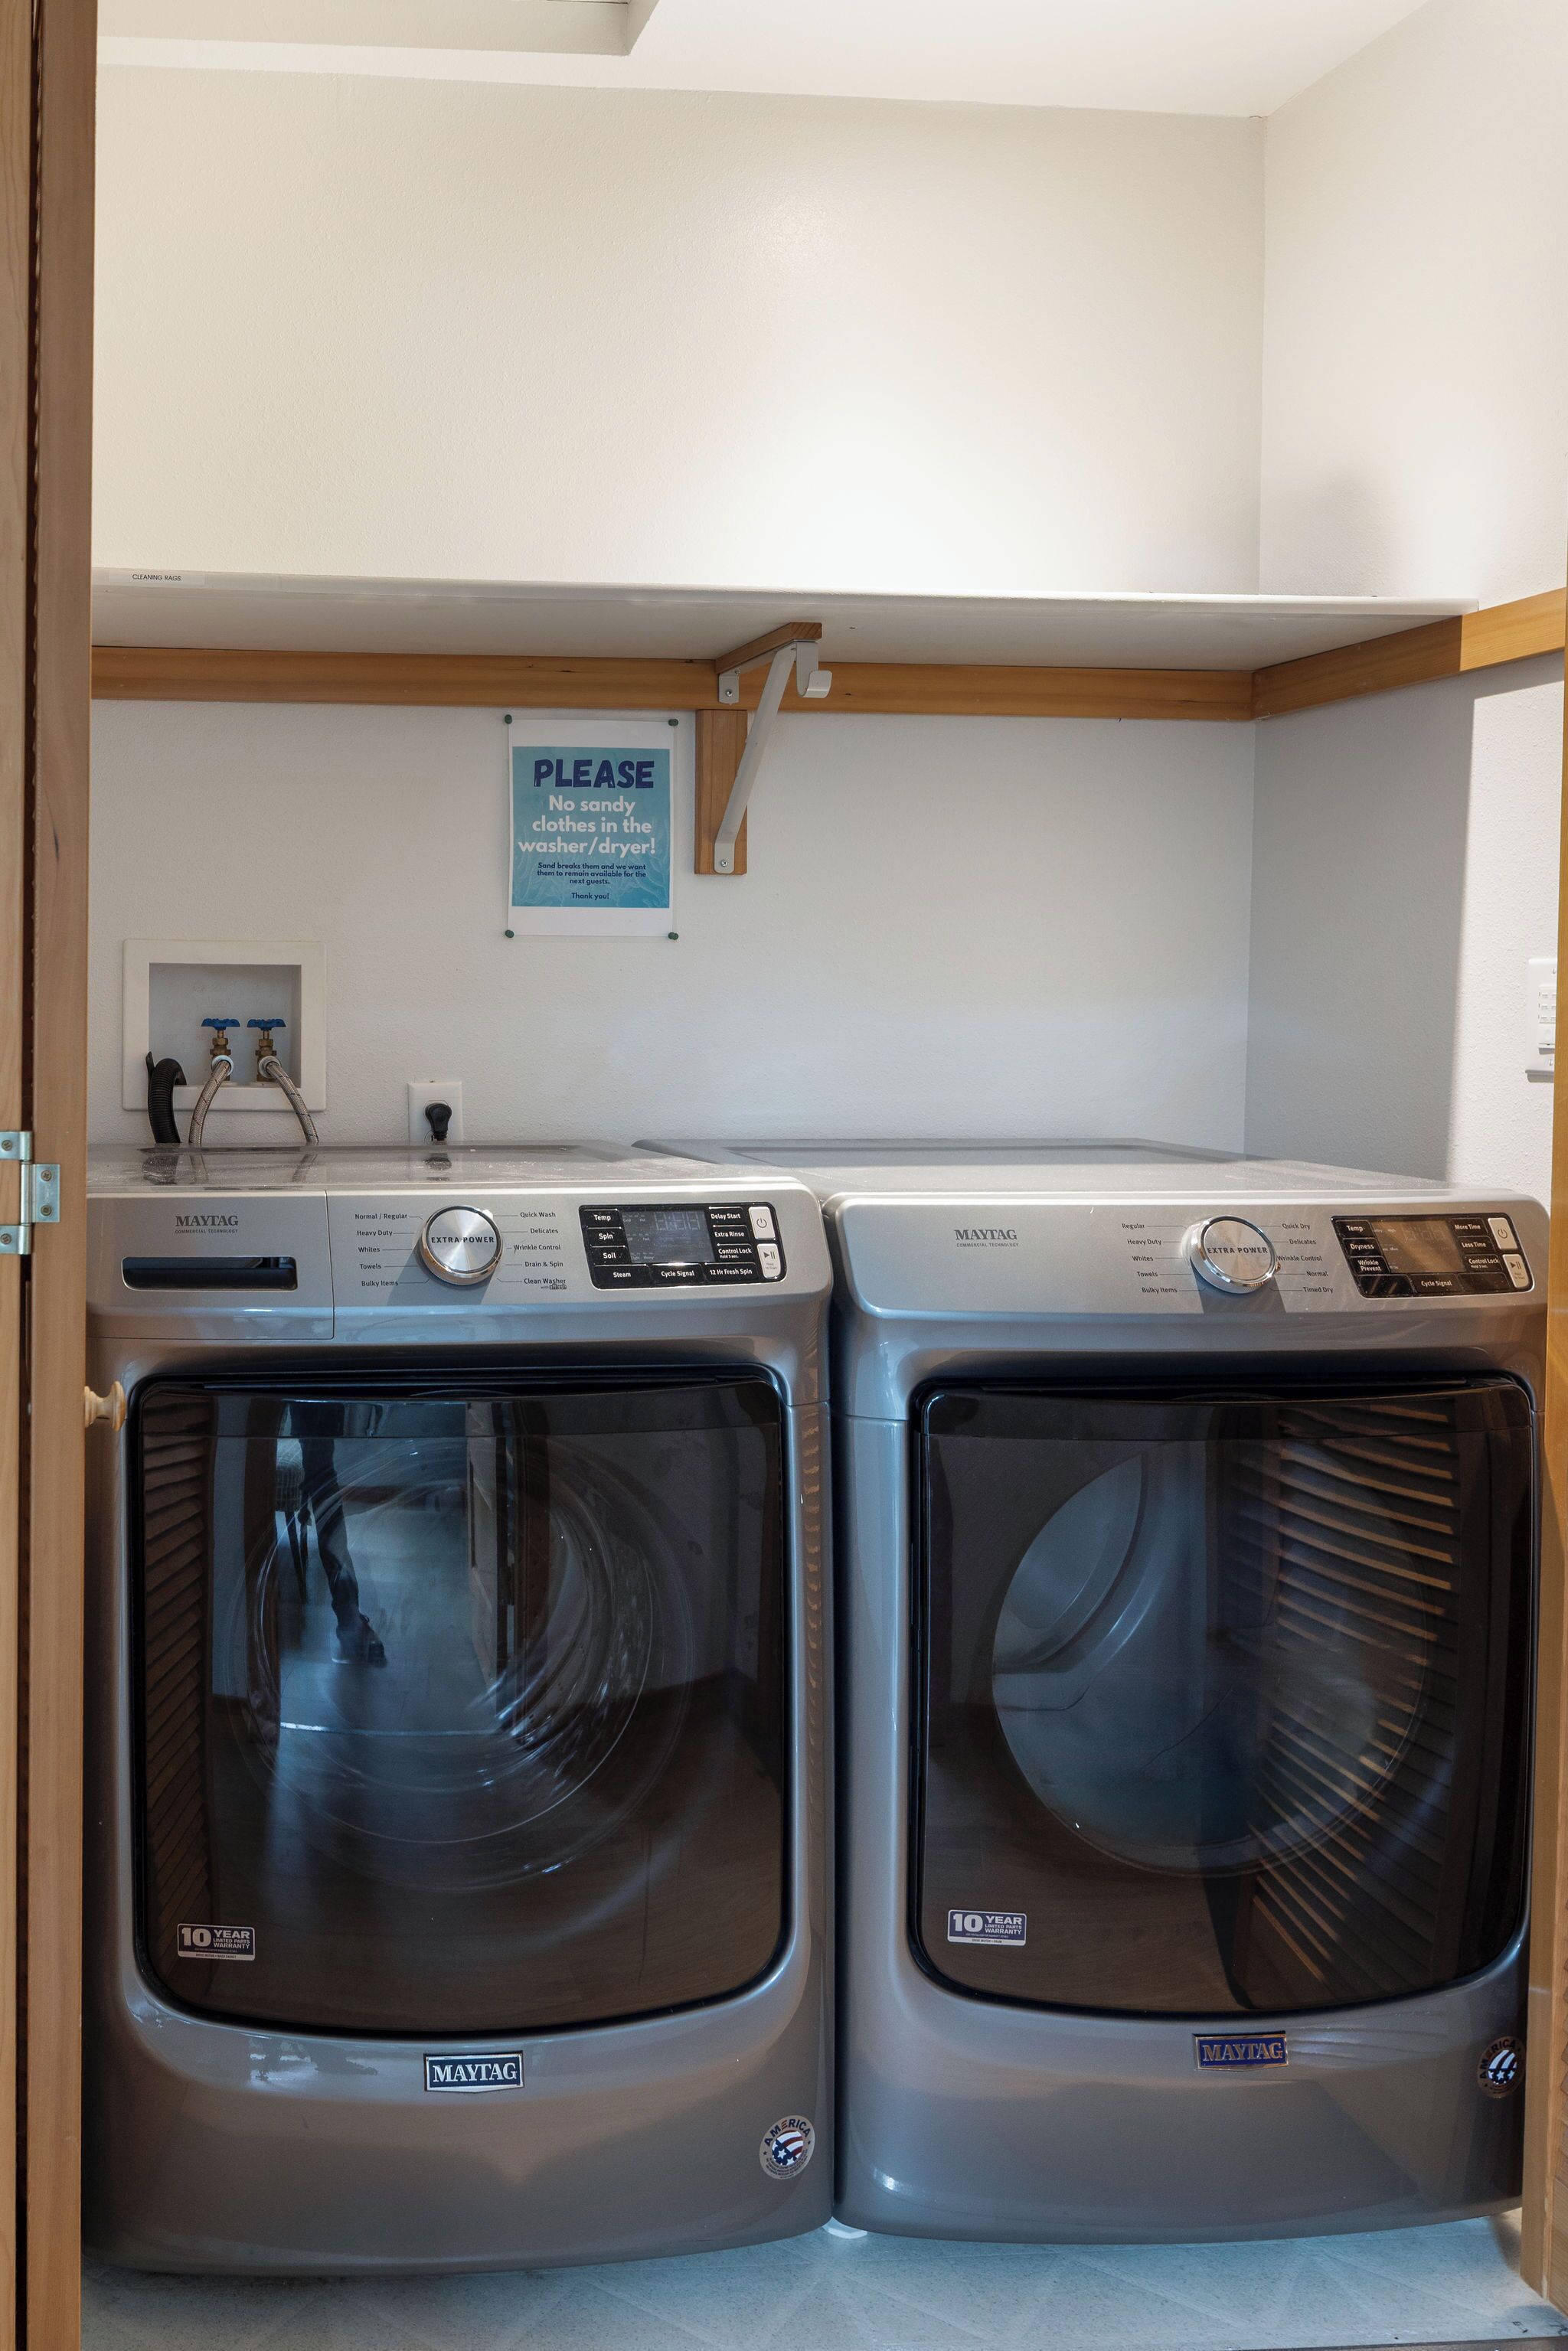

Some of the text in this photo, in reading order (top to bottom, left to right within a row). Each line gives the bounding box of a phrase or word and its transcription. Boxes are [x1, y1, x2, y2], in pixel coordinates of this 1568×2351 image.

[534, 759, 655, 789] PLEASE
[549, 795, 635, 816] No sandy
[532, 815, 652, 834] clothes in the
[518, 836, 655, 858] washer/dryer!
[175, 1215, 239, 1226] MAYTAG
[594, 1214, 611, 1223] Temp
[954, 1229, 1018, 1240] MAYTAG
[952, 1913, 1022, 1932] 10 YEAR
[181, 1927, 250, 1947] 10 YEAR
[1202, 2042, 1283, 2062] MAYTAG
[433, 2062, 518, 2082] MAYTAG
[764, 2118, 811, 2147] AMERICA
